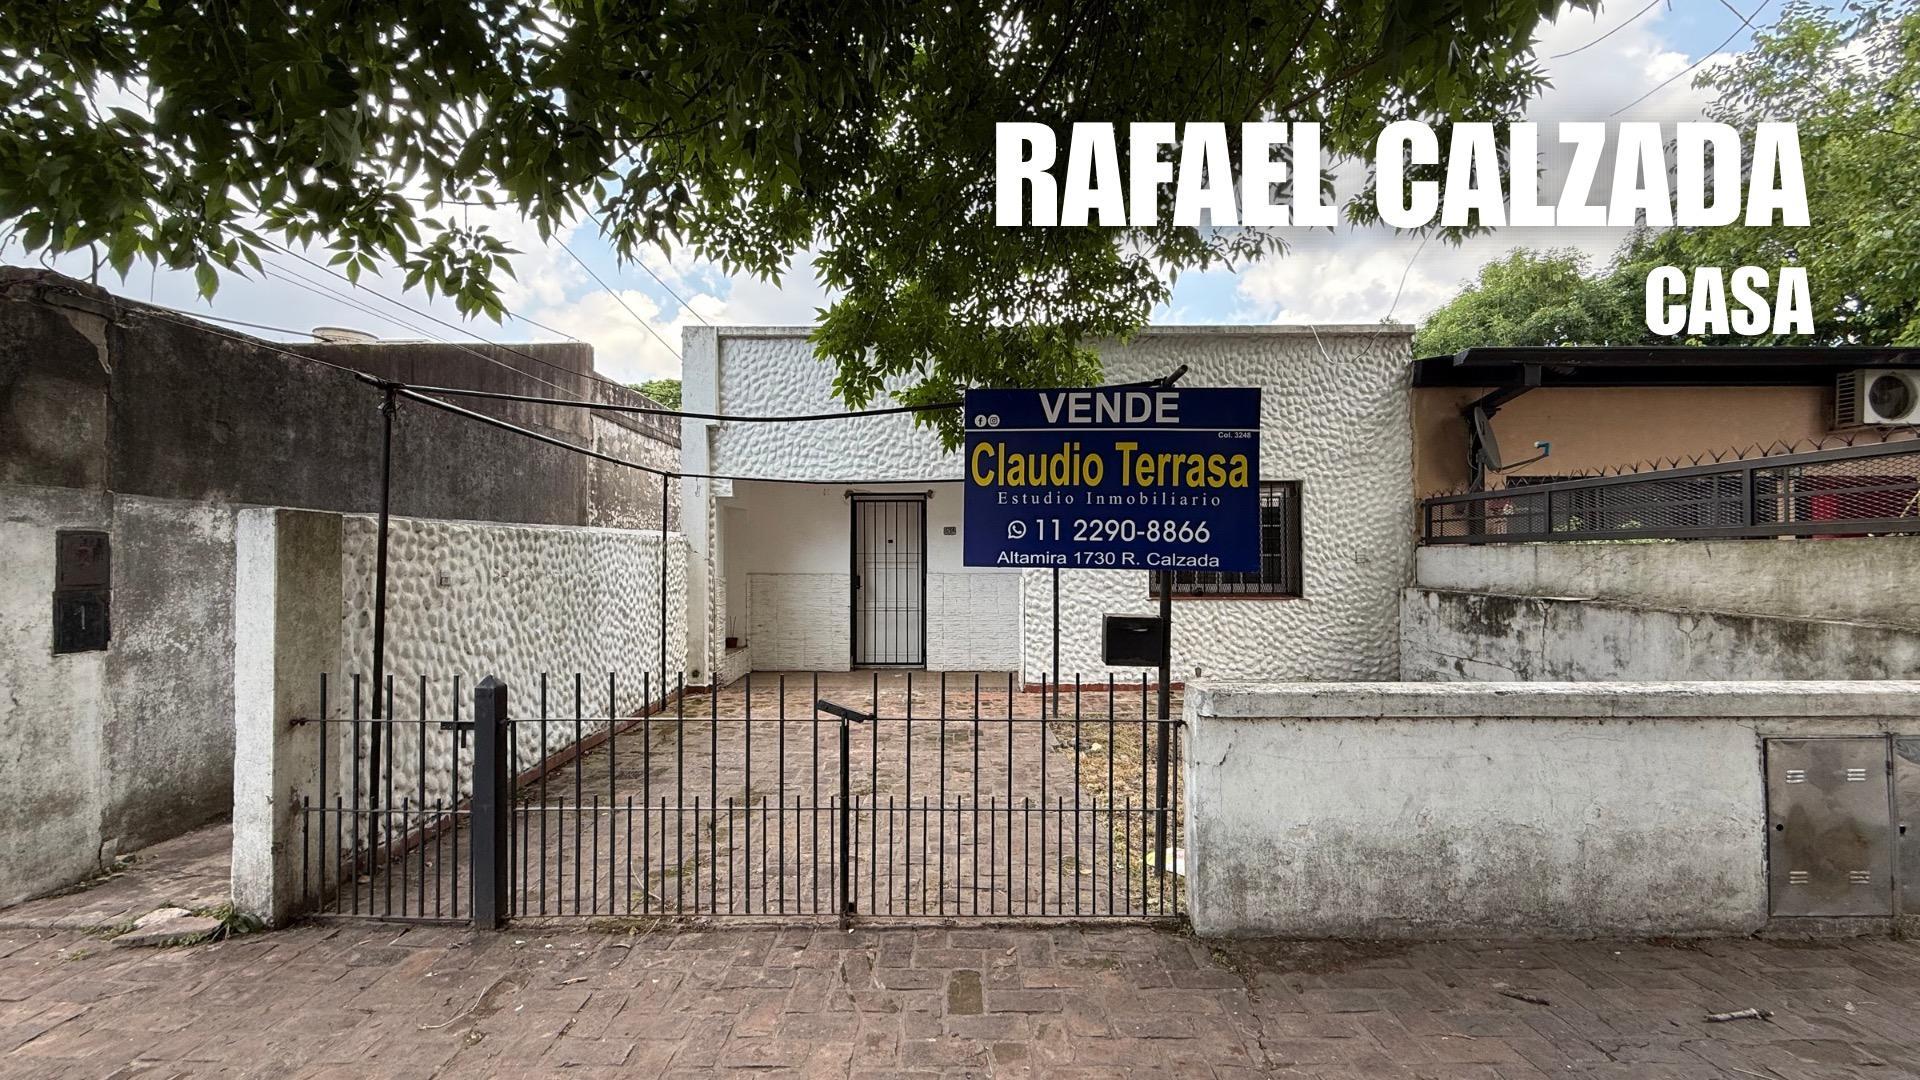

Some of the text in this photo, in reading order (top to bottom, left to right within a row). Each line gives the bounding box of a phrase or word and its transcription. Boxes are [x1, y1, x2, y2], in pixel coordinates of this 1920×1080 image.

[1039, 392, 1180, 424] VENDE
[1217, 431, 1233, 439] Col.
[971, 441, 1249, 488] Claudio Terrasa
[998, 491, 1221, 507] Estudio Inmobiliario
[1036, 519, 1211, 543] 11 2290-8866
[997, 551, 1220, 567] Altamira 1730 R. Calzada
